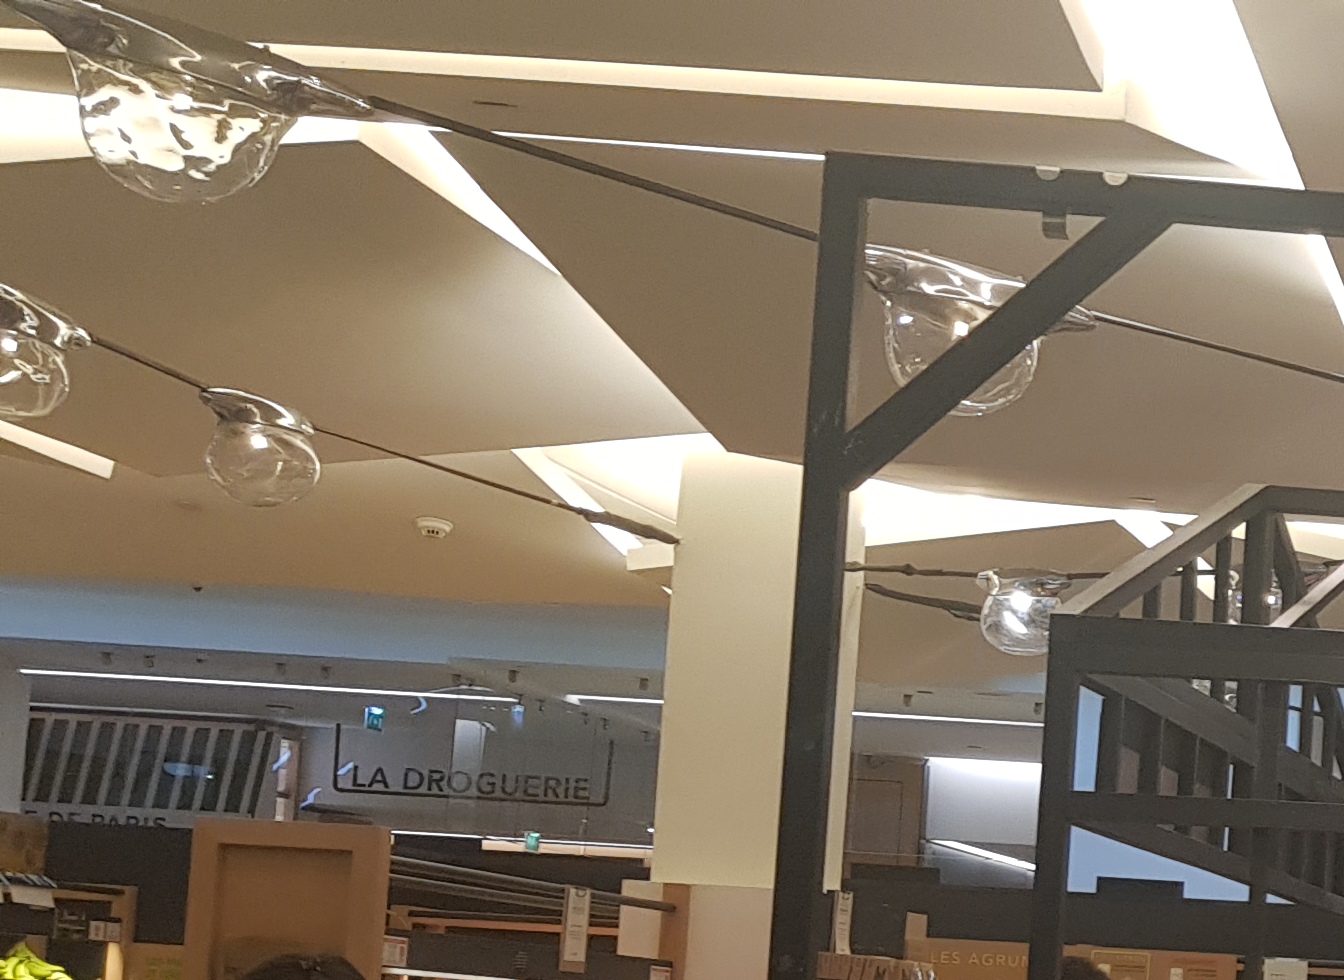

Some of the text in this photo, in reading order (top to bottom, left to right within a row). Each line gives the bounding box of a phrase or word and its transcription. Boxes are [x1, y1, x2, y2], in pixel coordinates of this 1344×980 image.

[351, 764, 591, 801] LA DROGUERIE
[930, 951, 961, 965] LES
